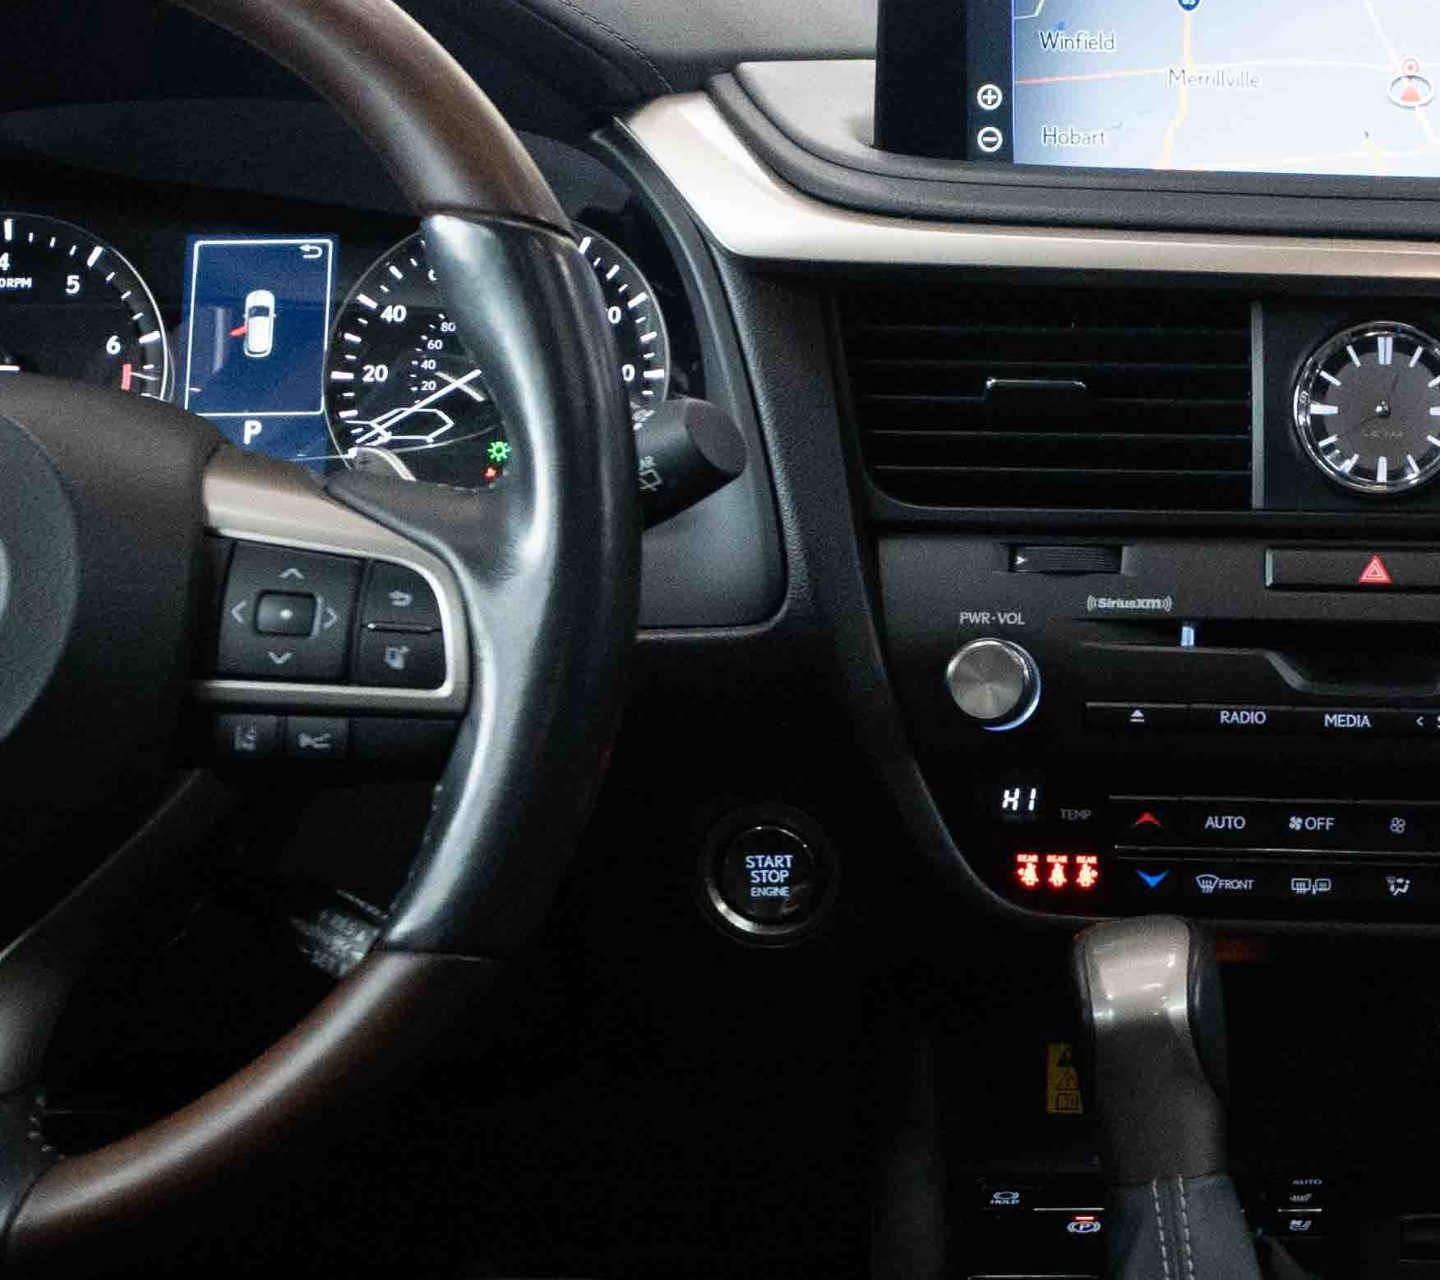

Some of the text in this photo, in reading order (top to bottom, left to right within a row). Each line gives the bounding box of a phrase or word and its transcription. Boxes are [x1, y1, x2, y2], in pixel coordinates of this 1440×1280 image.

[1040, 31, 1116, 51] Winfield
[1167, 68, 1261, 89] Merrillville
[1042, 126, 1106, 146] Hobart
[66, 275, 81, 295] 5
[380, 304, 407, 323] 40
[440, 321, 456, 333] 80
[106, 335, 121, 355] 6
[427, 338, 443, 351] 60
[421, 359, 437, 371] 40
[362, 363, 389, 383] 20
[421, 379, 437, 392] 20
[243, 420, 263, 445] P
[1220, 710, 1267, 725] RADIO
[1324, 714, 1372, 729] MEDIA
[1002, 787, 1037, 811] HI
[1060, 808, 1092, 820] TEMP
[1205, 816, 1246, 829] AUTO
[1304, 817, 1335, 831] OFF
[745, 855, 793, 869] START
[750, 869, 790, 883] STOP
[750, 886, 790, 897] ENGINE
[1218, 878, 1255, 891] FRONT
